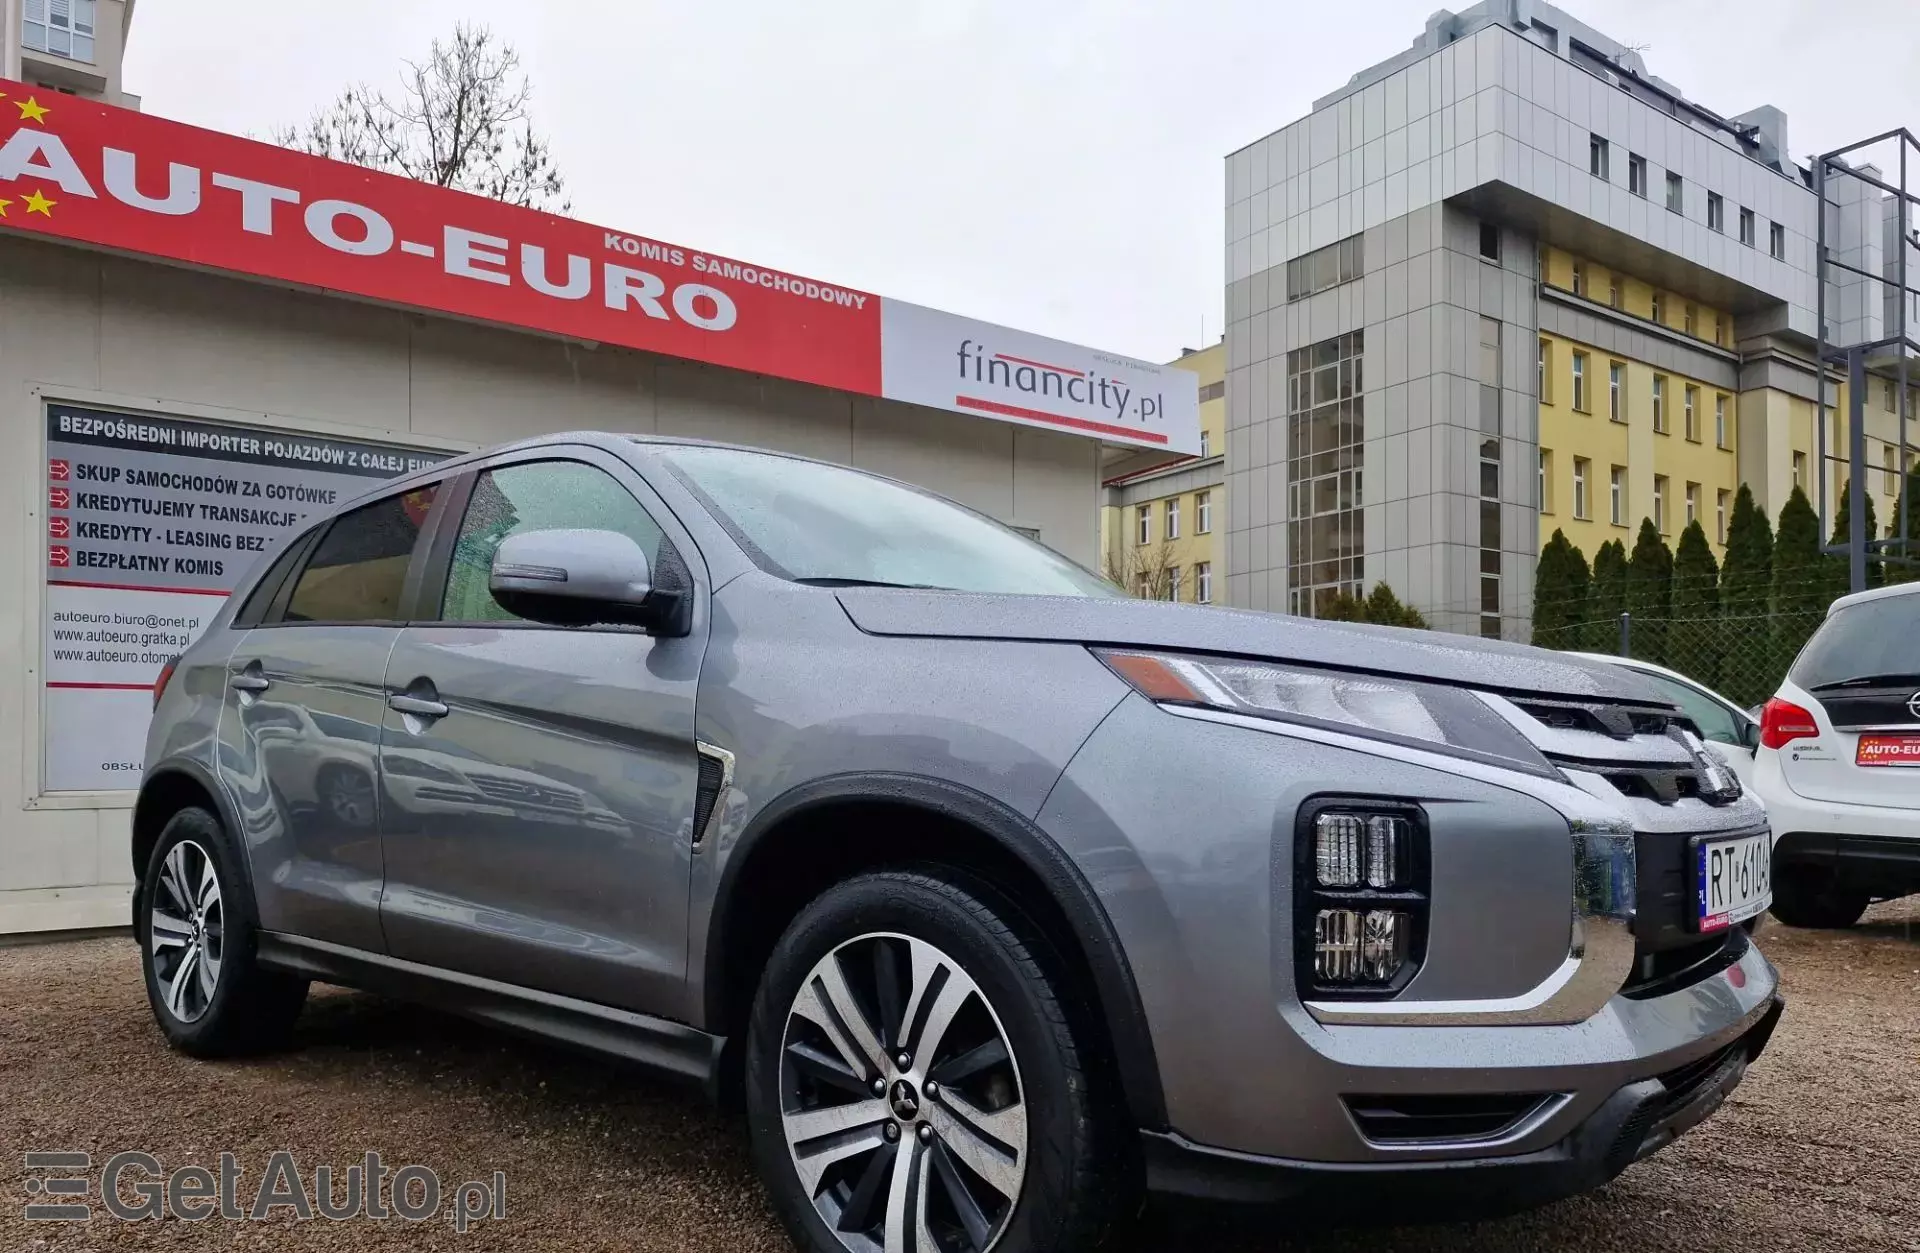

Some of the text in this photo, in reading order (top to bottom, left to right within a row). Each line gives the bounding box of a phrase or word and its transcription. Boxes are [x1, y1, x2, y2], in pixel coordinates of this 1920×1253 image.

[0, 127, 738, 332] AUTO-EURO
[604, 232, 867, 311] KOMIS SAMOCHODOWY
[957, 339, 1163, 422] financity.pl
[59, 415, 176, 445] BEZPOŚREDNI
[181, 430, 260, 456] IMPORTER
[264, 441, 344, 465] POJAZDÓW
[348, 453, 357, 466] Z
[361, 453, 404, 473] CAŁEJ
[76, 463, 121, 483] SKUP
[126, 468, 238, 495] SAMOCHODÓW
[242, 481, 261, 497] ZA
[76, 492, 195, 518] KREDYTUJEMY
[76, 521, 152, 543] KREDYTY
[166, 529, 231, 549] LEASING
[236, 535, 264, 551] BEZ
[76, 550, 224, 576] BEZPŁATNY KOMIS
[53, 611, 199, 630] autoeuro.biuro@onet.pl
[53, 629, 190, 648] www.autoeuro.gratka.pl
[1711, 846, 1735, 909] RT
